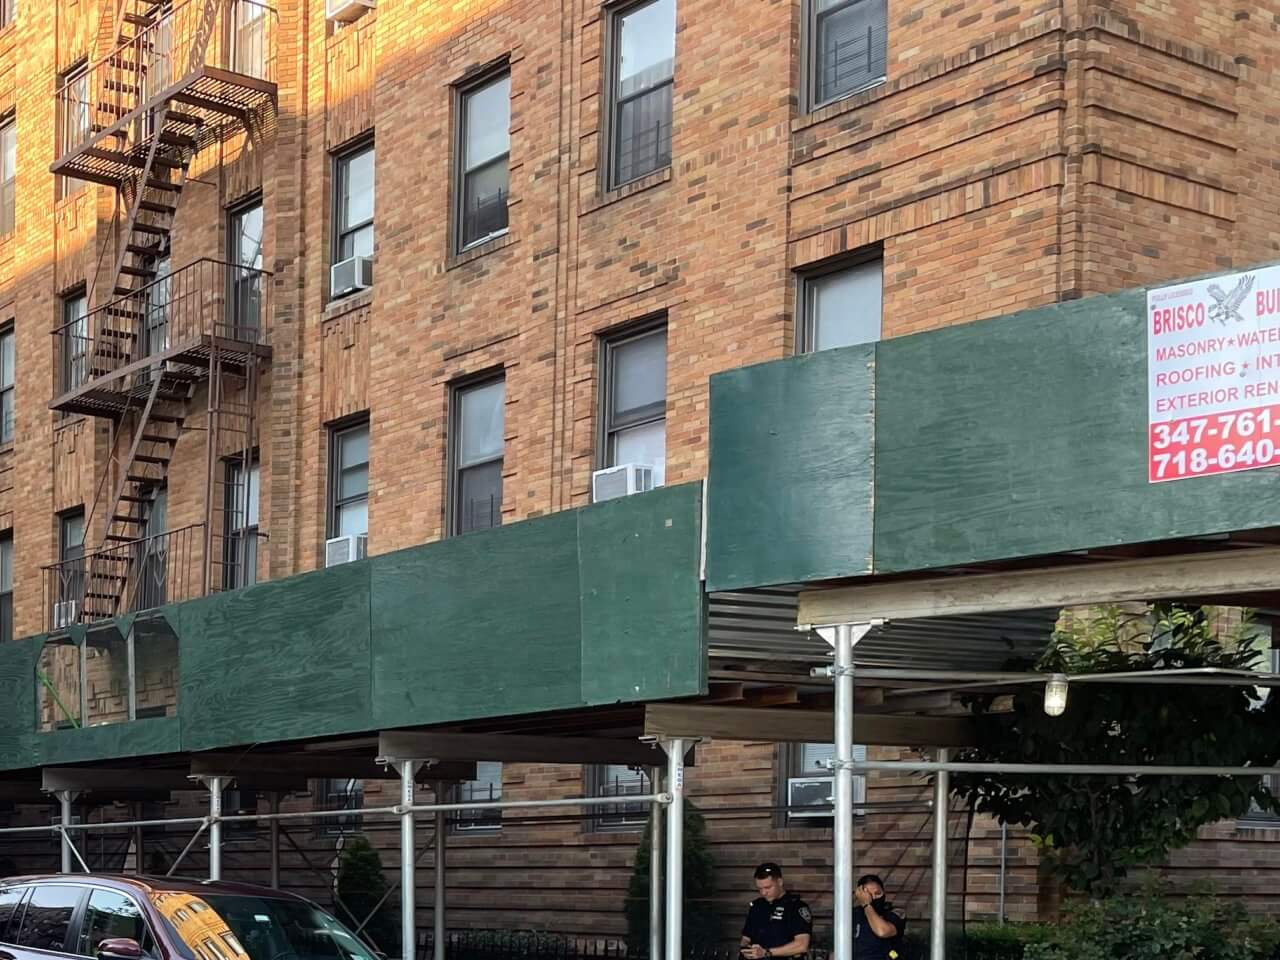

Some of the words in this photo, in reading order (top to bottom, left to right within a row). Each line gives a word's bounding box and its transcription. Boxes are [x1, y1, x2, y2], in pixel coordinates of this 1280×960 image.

[1153, 302, 1205, 335] BRISCO
[1156, 338, 1225, 361] MASONRY
[1157, 361, 1235, 387] ROOFING
[1157, 387, 1238, 413] EXTERIOR
[1244, 380, 1280, 399] REN
